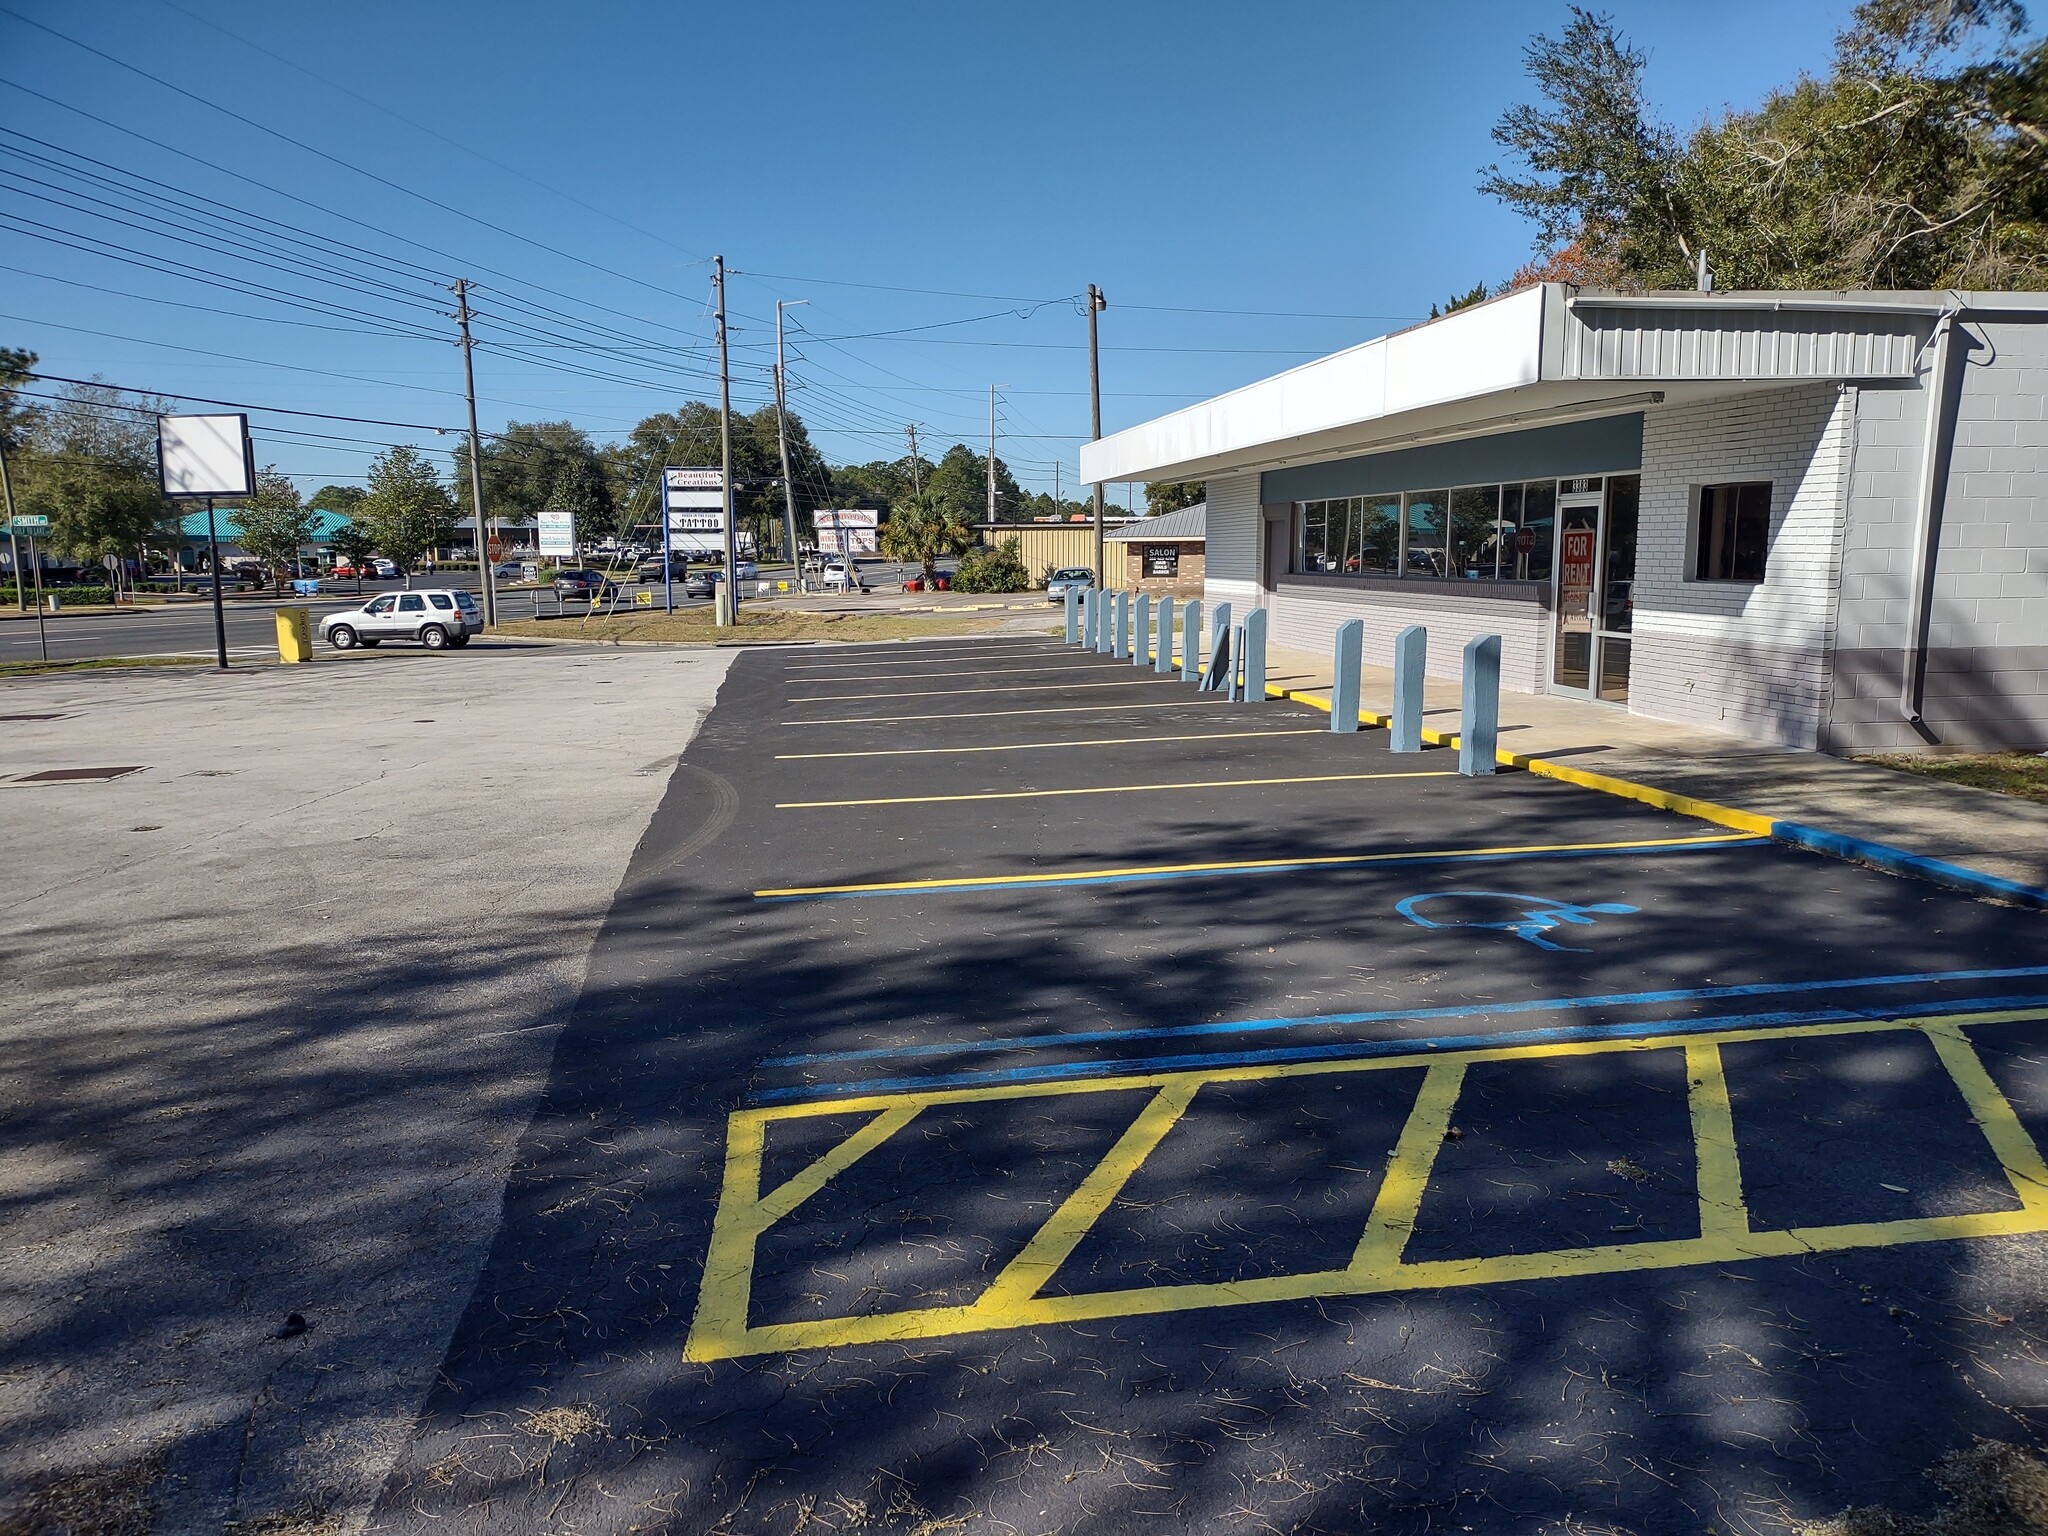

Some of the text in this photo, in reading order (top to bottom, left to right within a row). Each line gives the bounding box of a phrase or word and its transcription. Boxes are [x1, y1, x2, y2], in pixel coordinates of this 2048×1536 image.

[17, 516, 39, 525] SMITH
[680, 518, 719, 528] TATTOO
[851, 537, 874, 545] TOPS
[489, 543, 501, 555] STOP
[1567, 536, 1588, 557] FOR
[1149, 549, 1176, 557] SALON
[1564, 563, 1591, 584] RENT
